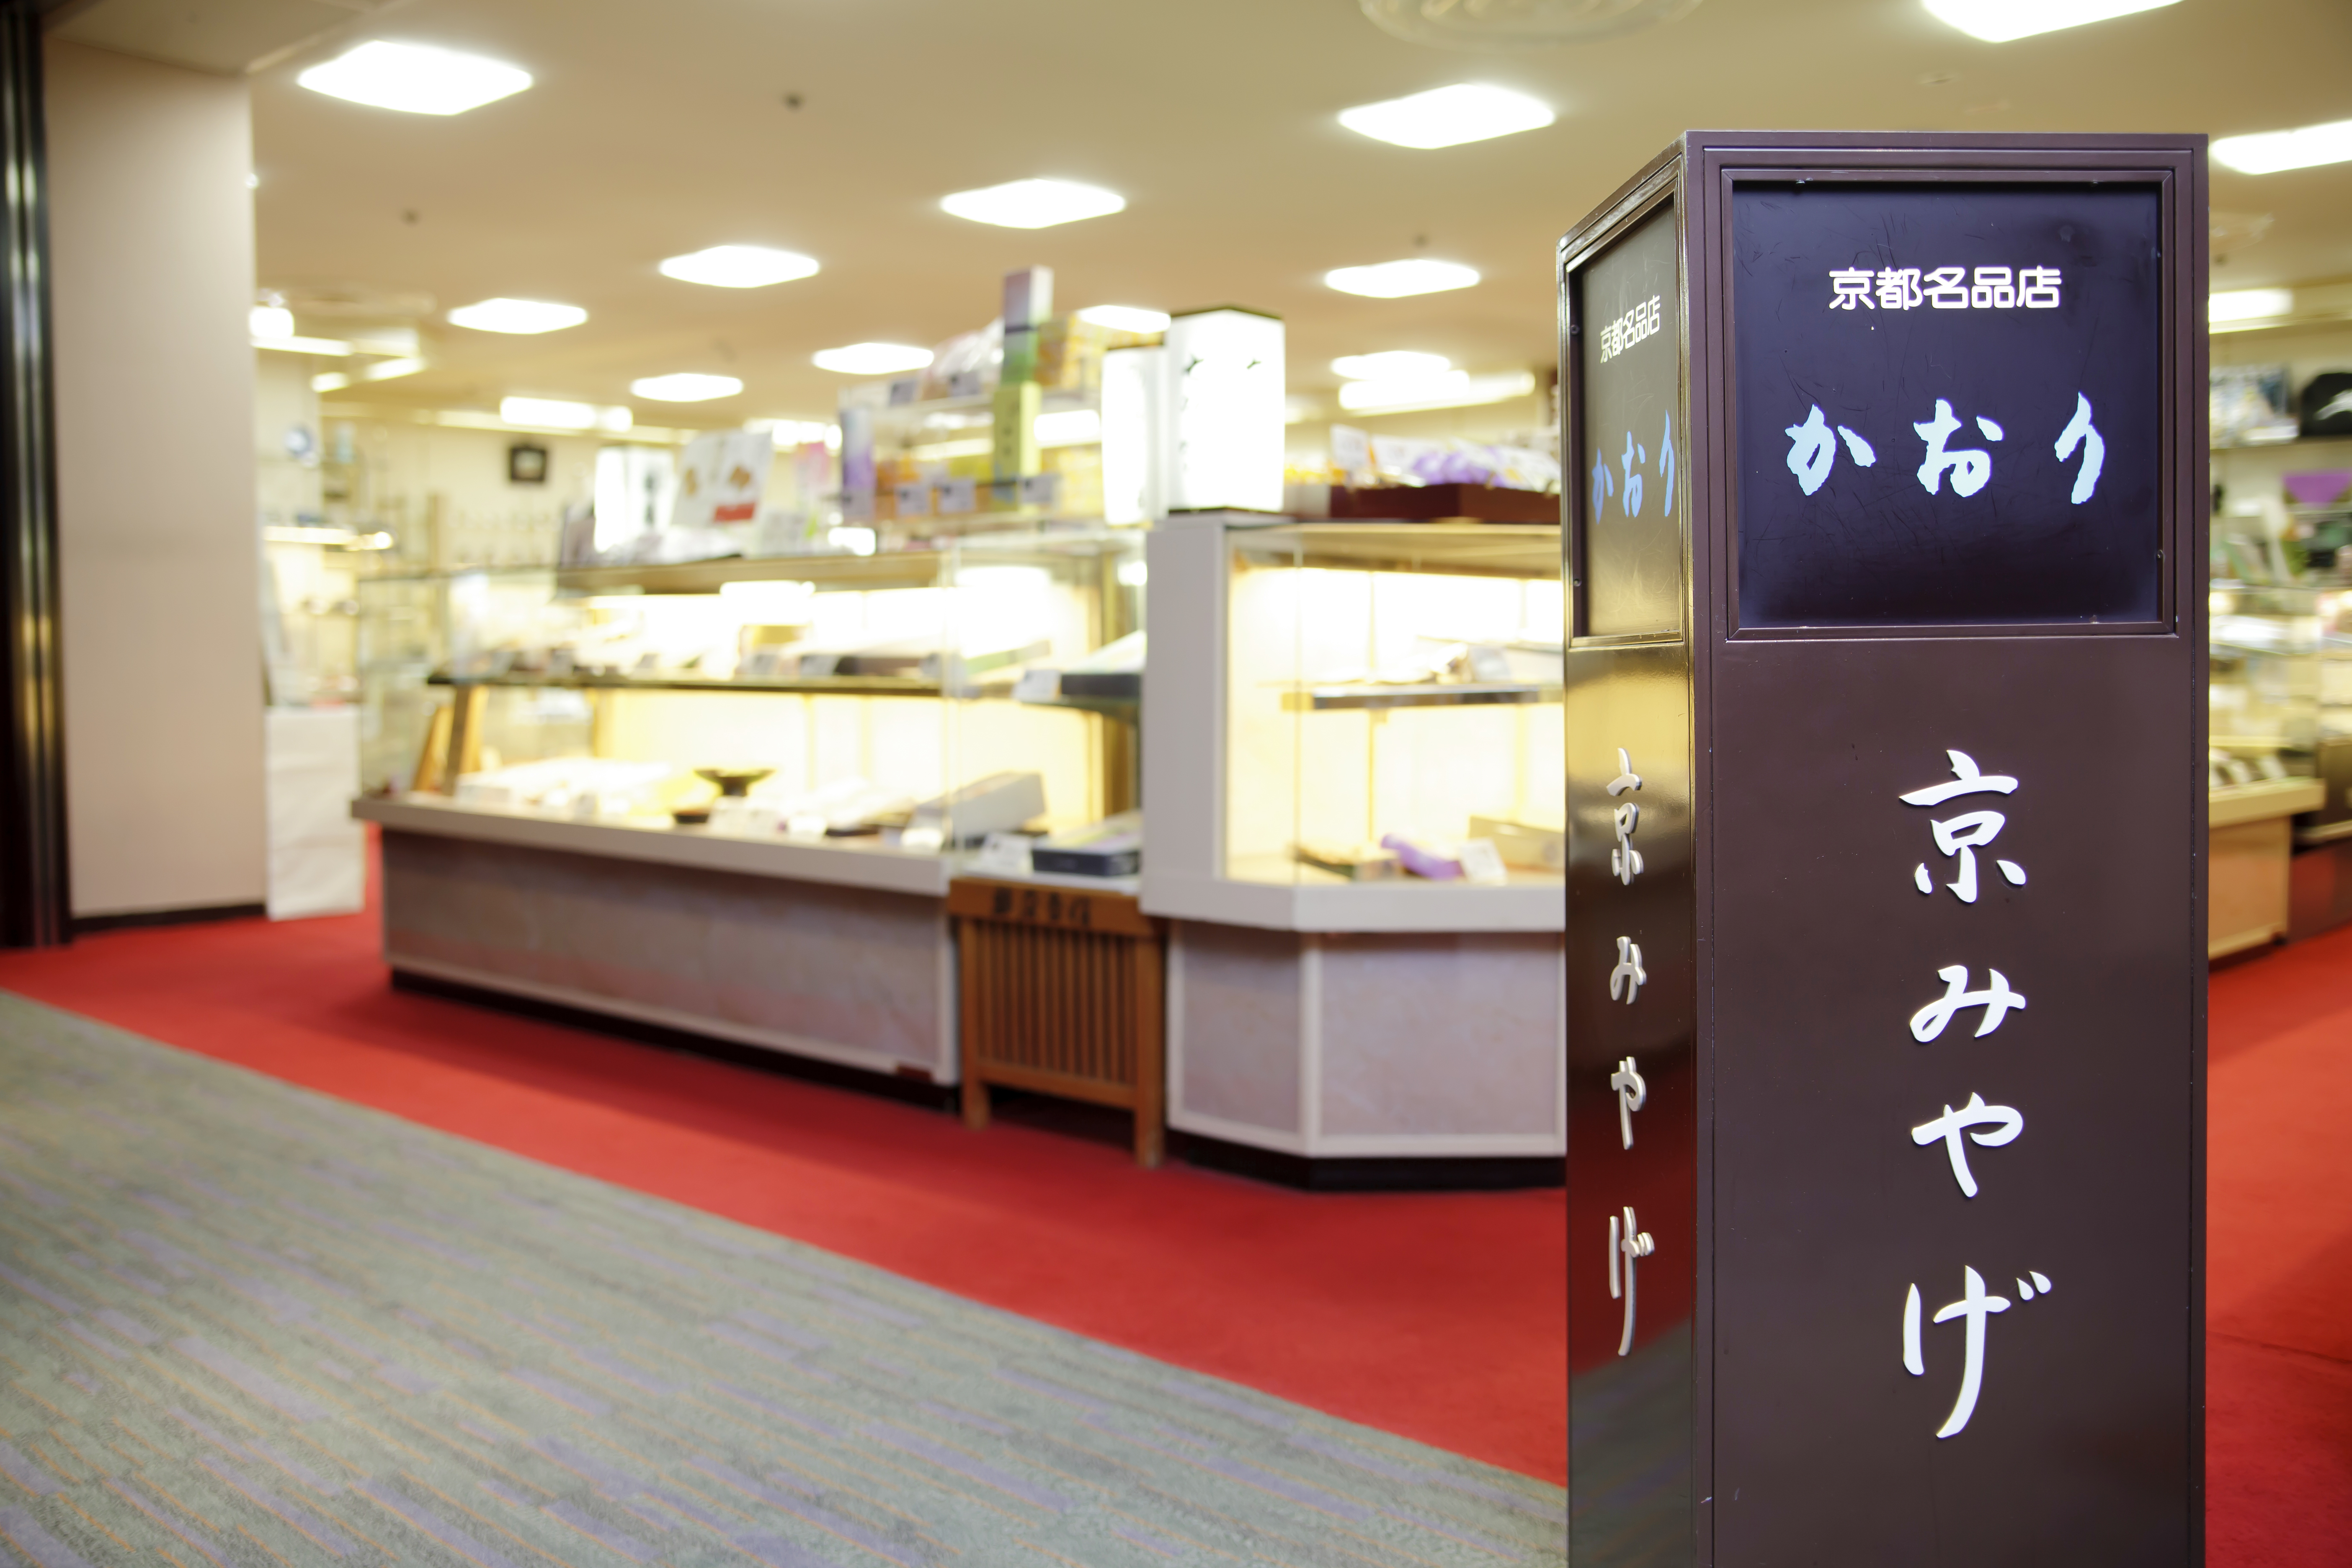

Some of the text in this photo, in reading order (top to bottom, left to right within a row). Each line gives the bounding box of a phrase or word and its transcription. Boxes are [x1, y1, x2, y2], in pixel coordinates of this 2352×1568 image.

[1600, 294, 1661, 364] 京都名品店
[1829, 266, 2062, 311] 京都名品店
[1592, 409, 1675, 524] かおり
[1785, 392, 2104, 504] かおり
[1607, 747, 1656, 1356] 京みやげ
[1899, 750, 2051, 1438] 京みやげ
